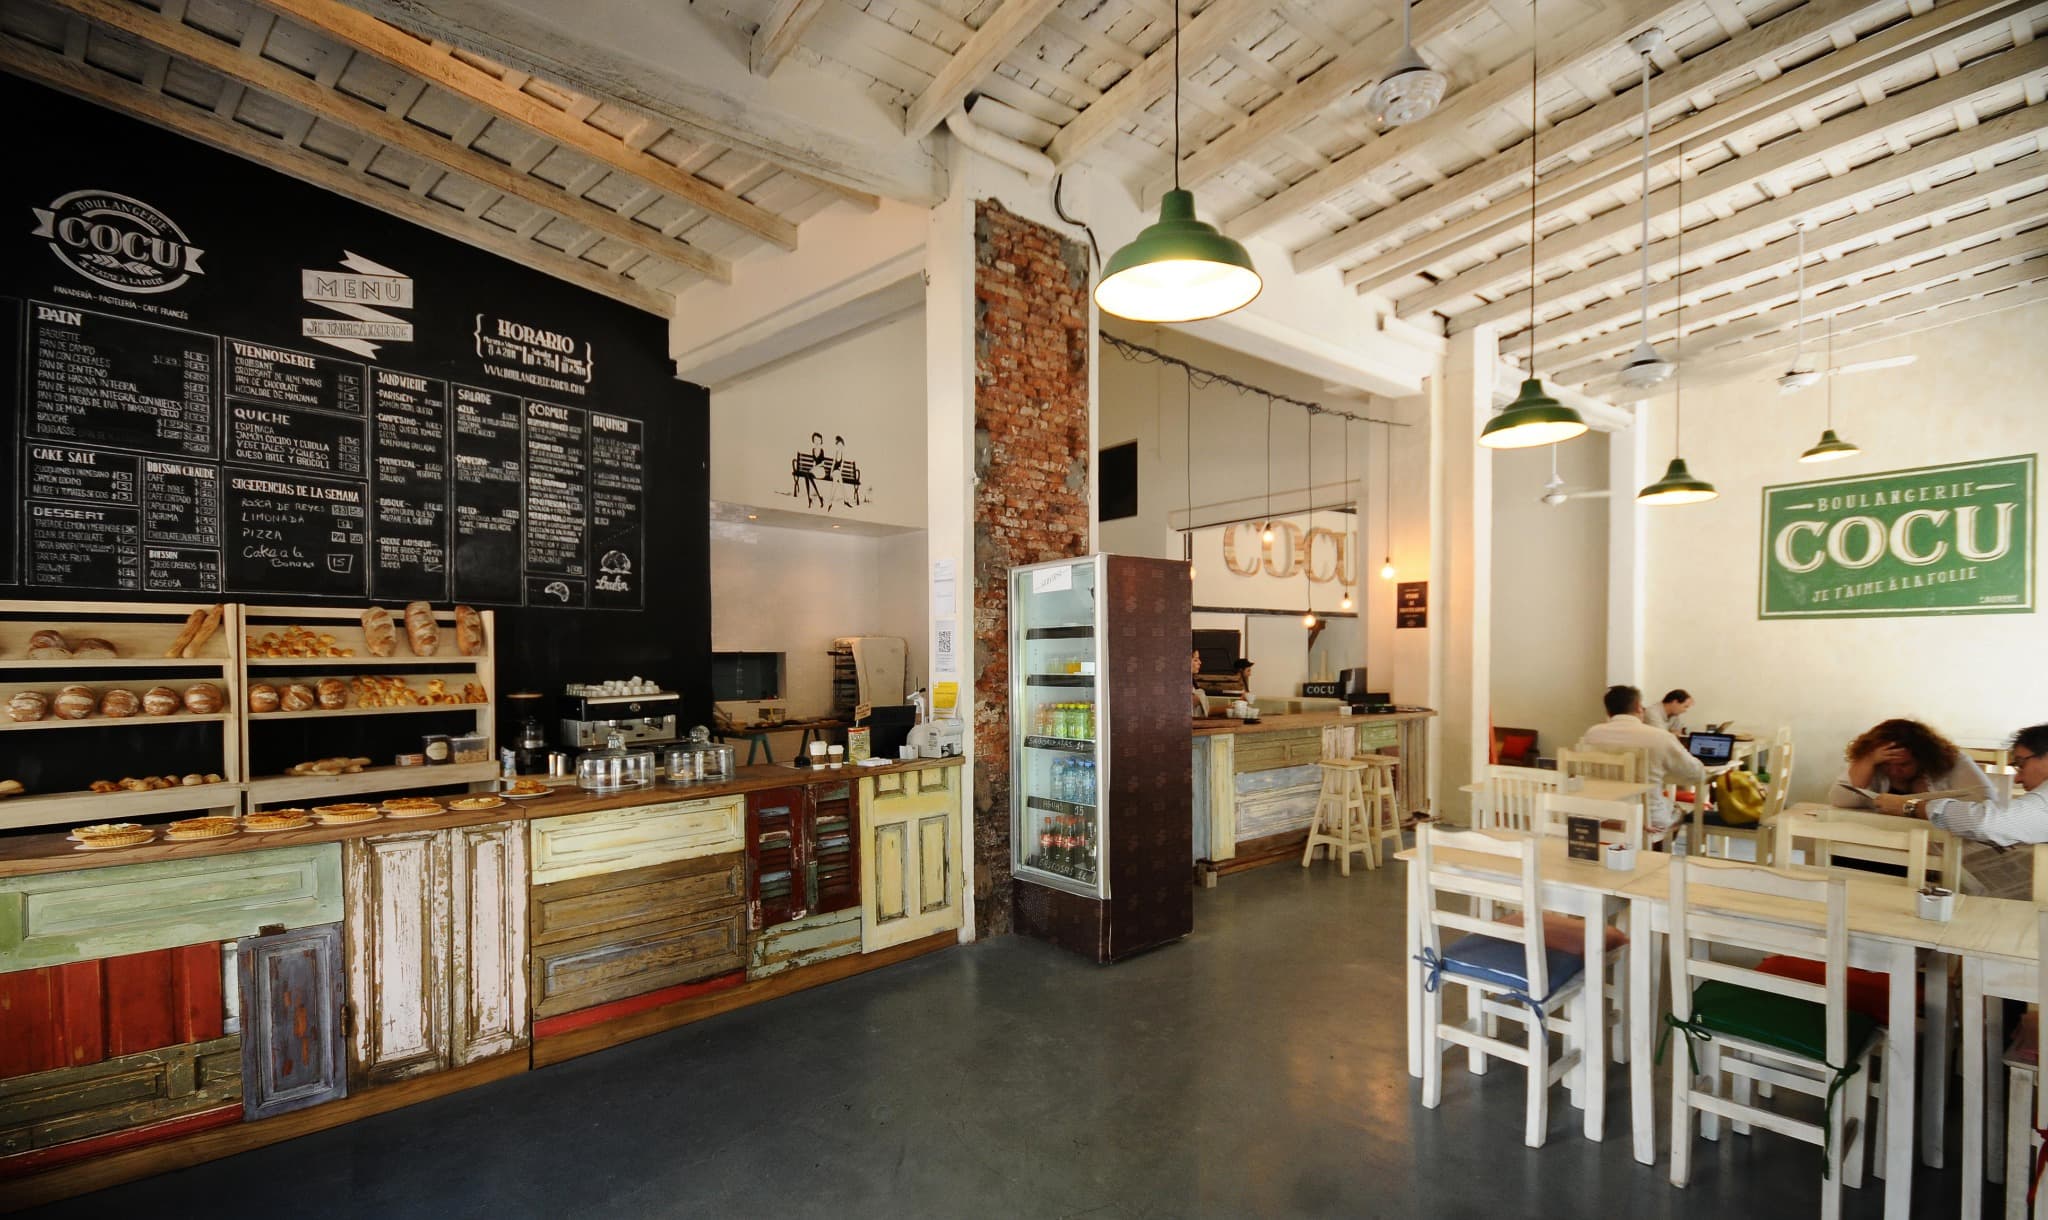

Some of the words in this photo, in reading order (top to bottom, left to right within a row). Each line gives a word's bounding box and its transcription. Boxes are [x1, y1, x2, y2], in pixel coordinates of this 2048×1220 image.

[75, 199, 169, 232] BOULANGERIE
[58, 217, 181, 269] COCU
[317, 277, 401, 302] MENÚ
[37, 306, 82, 327] PAIN
[497, 319, 574, 354] HORARIO
[233, 342, 316, 369] VIENNOISERIE
[457, 388, 492, 405] SALADE
[234, 408, 292, 426] QUICHE
[529, 402, 569, 421] FORMULE
[593, 415, 629, 433] BRUNCH
[33, 447, 64, 462] CAKE
[236, 440, 285, 455] VEGETALES
[295, 448, 329, 461] QUESO
[236, 449, 262, 461] QUESO
[232, 479, 295, 496] SUGERENCIAS
[296, 485, 309, 497] DE
[310, 486, 324, 499] LA
[324, 488, 359, 503] SEMANA
[1817, 482, 1976, 513] BOULANGERIE
[33, 506, 105, 520] DESSERT
[276, 502, 289, 511] DE
[241, 512, 305, 523] LIMONADA
[242, 527, 282, 541] PIZZA
[1775, 502, 2019, 573] COCU
[1223, 519, 1358, 586] COCU
[1812, 589, 1829, 603] JE
[1835, 581, 1884, 600] T'AIME
[1927, 567, 1978, 587] FOLIE
[1306, 684, 1335, 695] COCU
